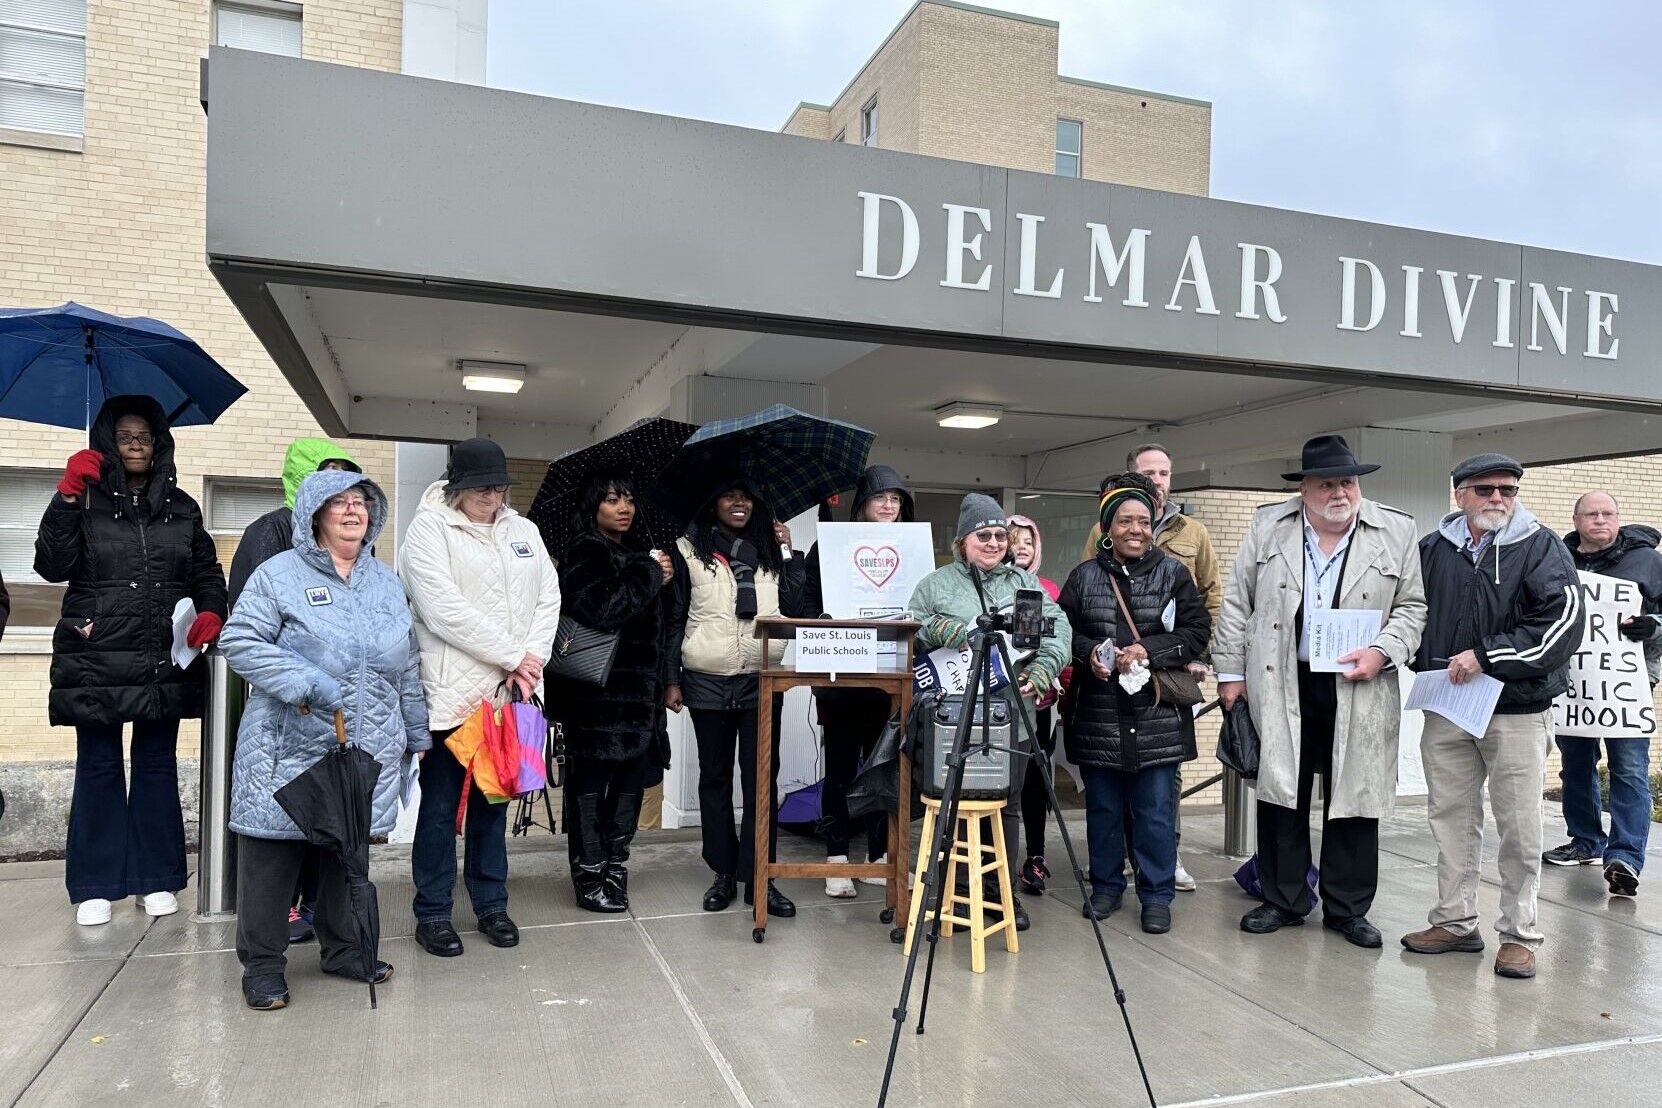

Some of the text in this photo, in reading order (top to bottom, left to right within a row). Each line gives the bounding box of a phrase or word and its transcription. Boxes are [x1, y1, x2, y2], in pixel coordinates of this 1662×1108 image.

[855, 190, 1620, 361] DELMAR DIVINE
[802, 630, 872, 640] Save St. Louis
[802, 646, 831, 655] Public
[833, 646, 869, 655] Schools
[1314, 637, 1322, 657] Media
[1569, 651, 1638, 673] TES
